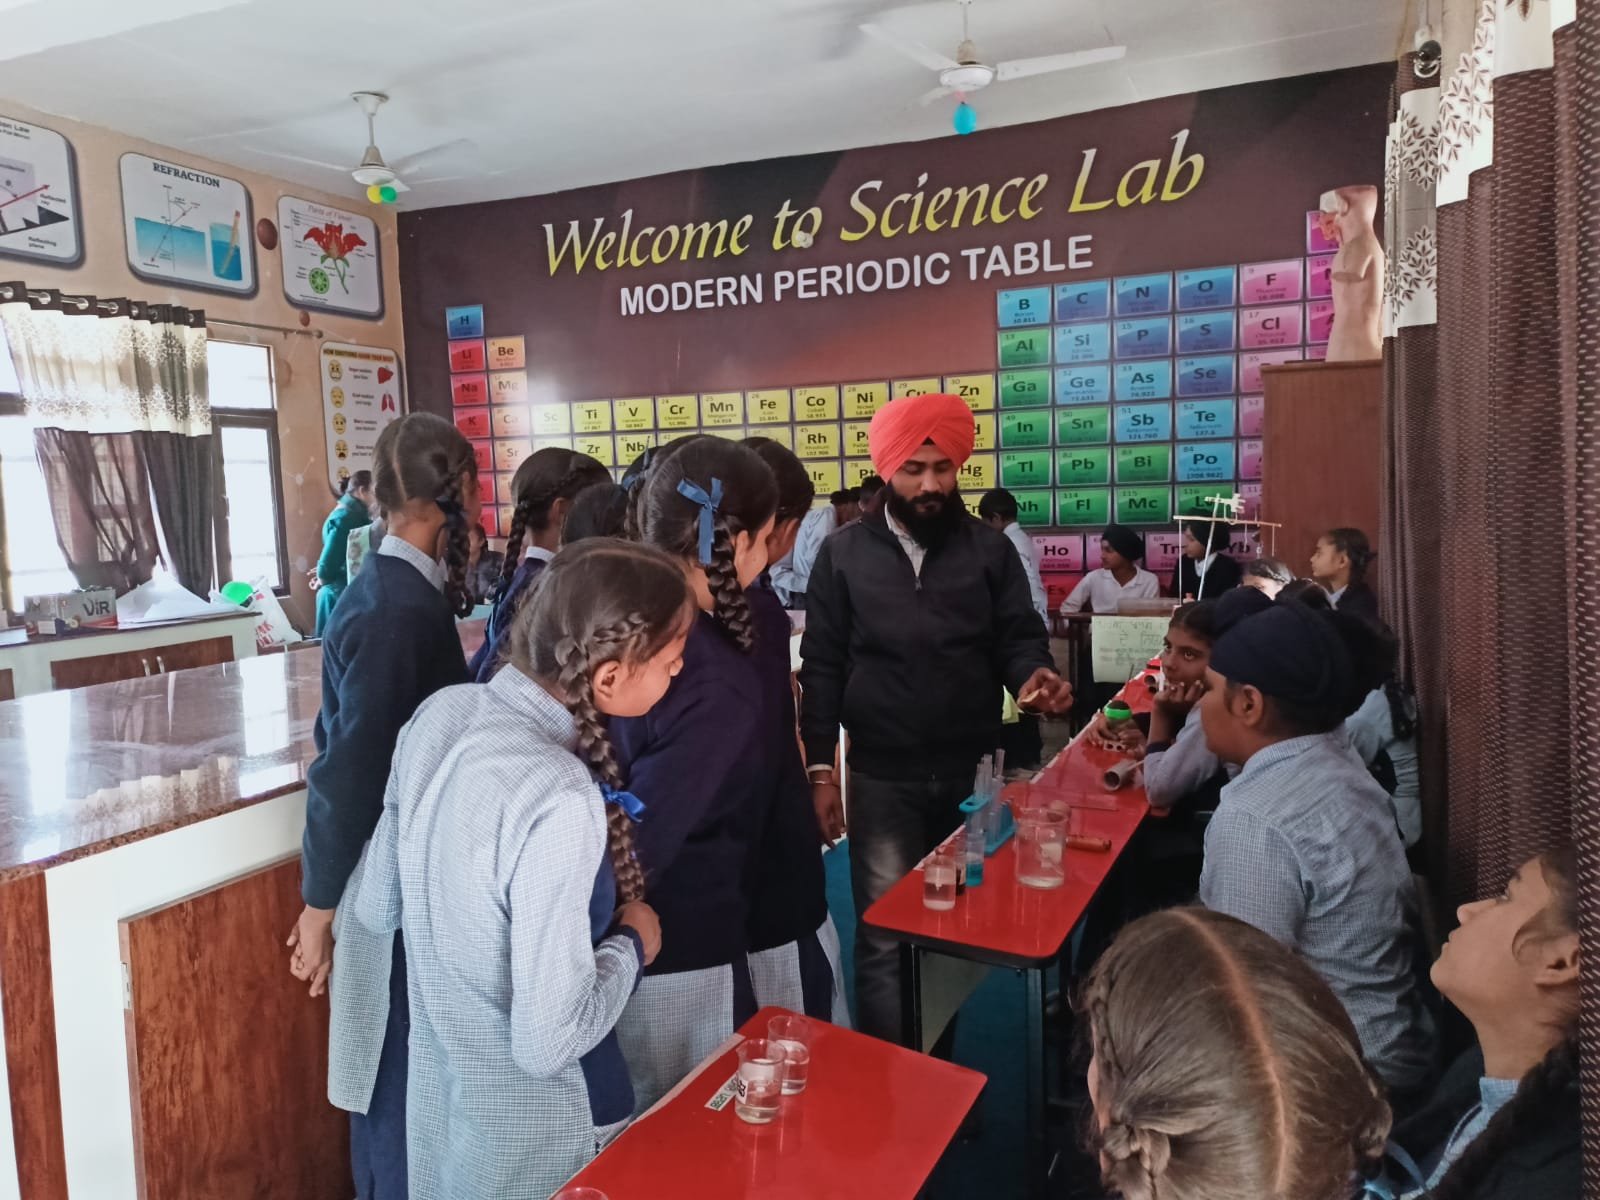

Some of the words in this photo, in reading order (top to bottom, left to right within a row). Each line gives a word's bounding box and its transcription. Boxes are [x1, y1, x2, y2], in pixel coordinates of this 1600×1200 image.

[152, 162, 220, 188] REFRACTION
[542, 207, 754, 278] Welcome
[774, 199, 822, 252] to
[840, 172, 1049, 242] Science
[1067, 128, 1206, 213] Lab
[620, 272, 763, 316] MODERN
[774, 250, 951, 302] PERIODIC
[960, 234, 1094, 281] TABLE
[1266, 273, 1277, 286] F
[1197, 279, 1214, 293] O
[1076, 292, 1089, 304] C
[1135, 286, 1150, 299] N
[1018, 298, 1031, 310] B
[459, 315, 470, 325] H
[1261, 317, 1280, 331] Cl
[1137, 329, 1149, 341] P
[1200, 323, 1212, 336] S
[1015, 339, 1033, 352] Al
[1074, 334, 1090, 347] Si
[497, 346, 515, 357] Be
[1131, 372, 1155, 384] As
[1193, 368, 1217, 380] Se
[461, 383, 478, 393] Na
[498, 381, 520, 392] Mg
[1012, 381, 1037, 392] Ga
[1070, 376, 1096, 388] Ge
[857, 391, 874, 403] Ni
[959, 385, 980, 397] Zn
[710, 402, 735, 413] Mn
[759, 399, 777, 410] Fe
[806, 396, 826, 407] Co
[585, 408, 598, 419] Ti
[628, 407, 639, 417] V
[669, 404, 686, 415] Cr
[468, 415, 476, 426] K
[503, 414, 518, 424] Ca
[1131, 413, 1155, 426] Sb
[1194, 411, 1216, 422] Te
[1017, 422, 1033, 433] In
[1071, 418, 1094, 430] Sn
[807, 433, 827, 444] Rh
[507, 448, 519, 458] Sr
[587, 445, 601, 454] Zr
[626, 442, 645, 452] Nb
[1071, 458, 1095, 471] Pb
[1134, 456, 1152, 468] Bi
[1193, 453, 1218, 465] Po
[960, 464, 983, 477] Hg
[1018, 461, 1033, 473] Tl
[813, 471, 824, 481] Ir
[1017, 501, 1039, 512] Nh
[1076, 499, 1091, 511] Fl
[1128, 498, 1158, 509] Mc
[1044, 545, 1069, 556] Ho
